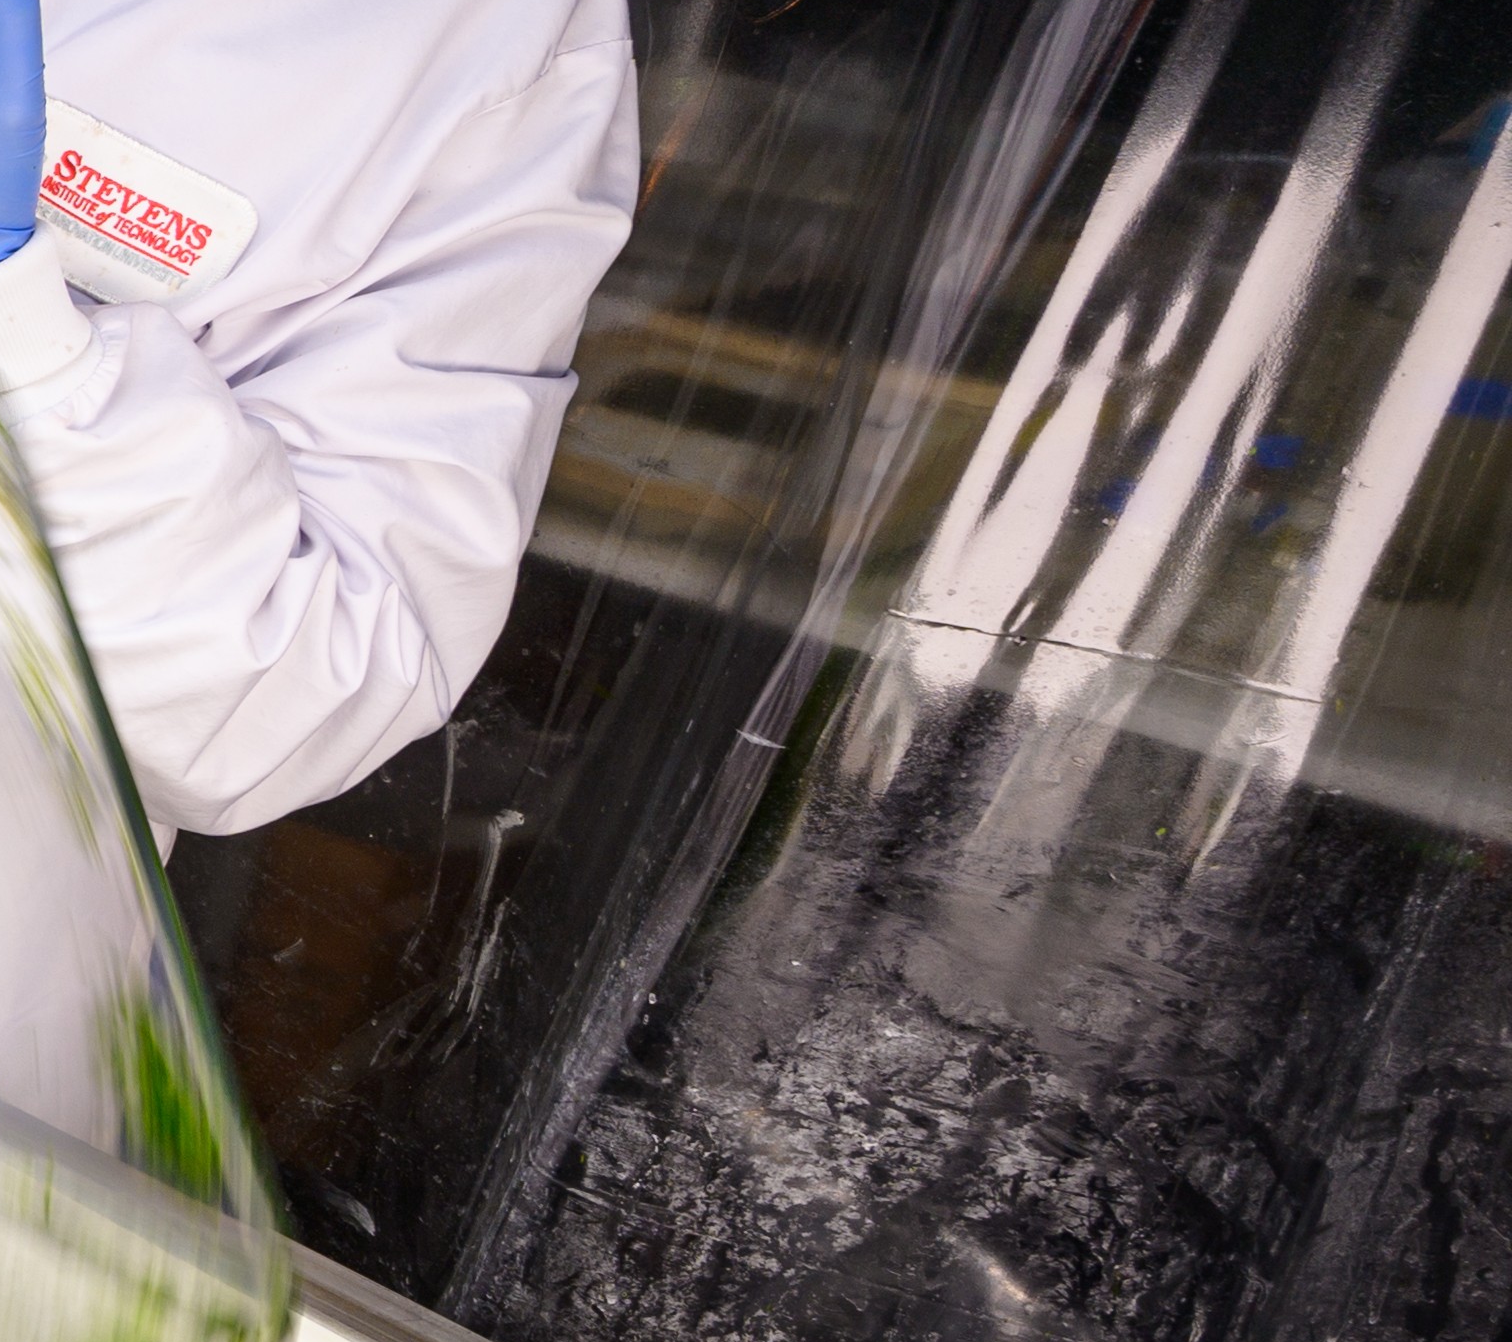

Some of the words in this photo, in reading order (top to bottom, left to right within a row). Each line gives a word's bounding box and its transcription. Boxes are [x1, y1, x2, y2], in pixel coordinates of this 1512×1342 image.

[41, 174, 100, 217] INSTITUTE
[96, 210, 115, 226] of
[114, 215, 202, 267] TECHNOLOGY
[53, 150, 213, 251] STEVENS
